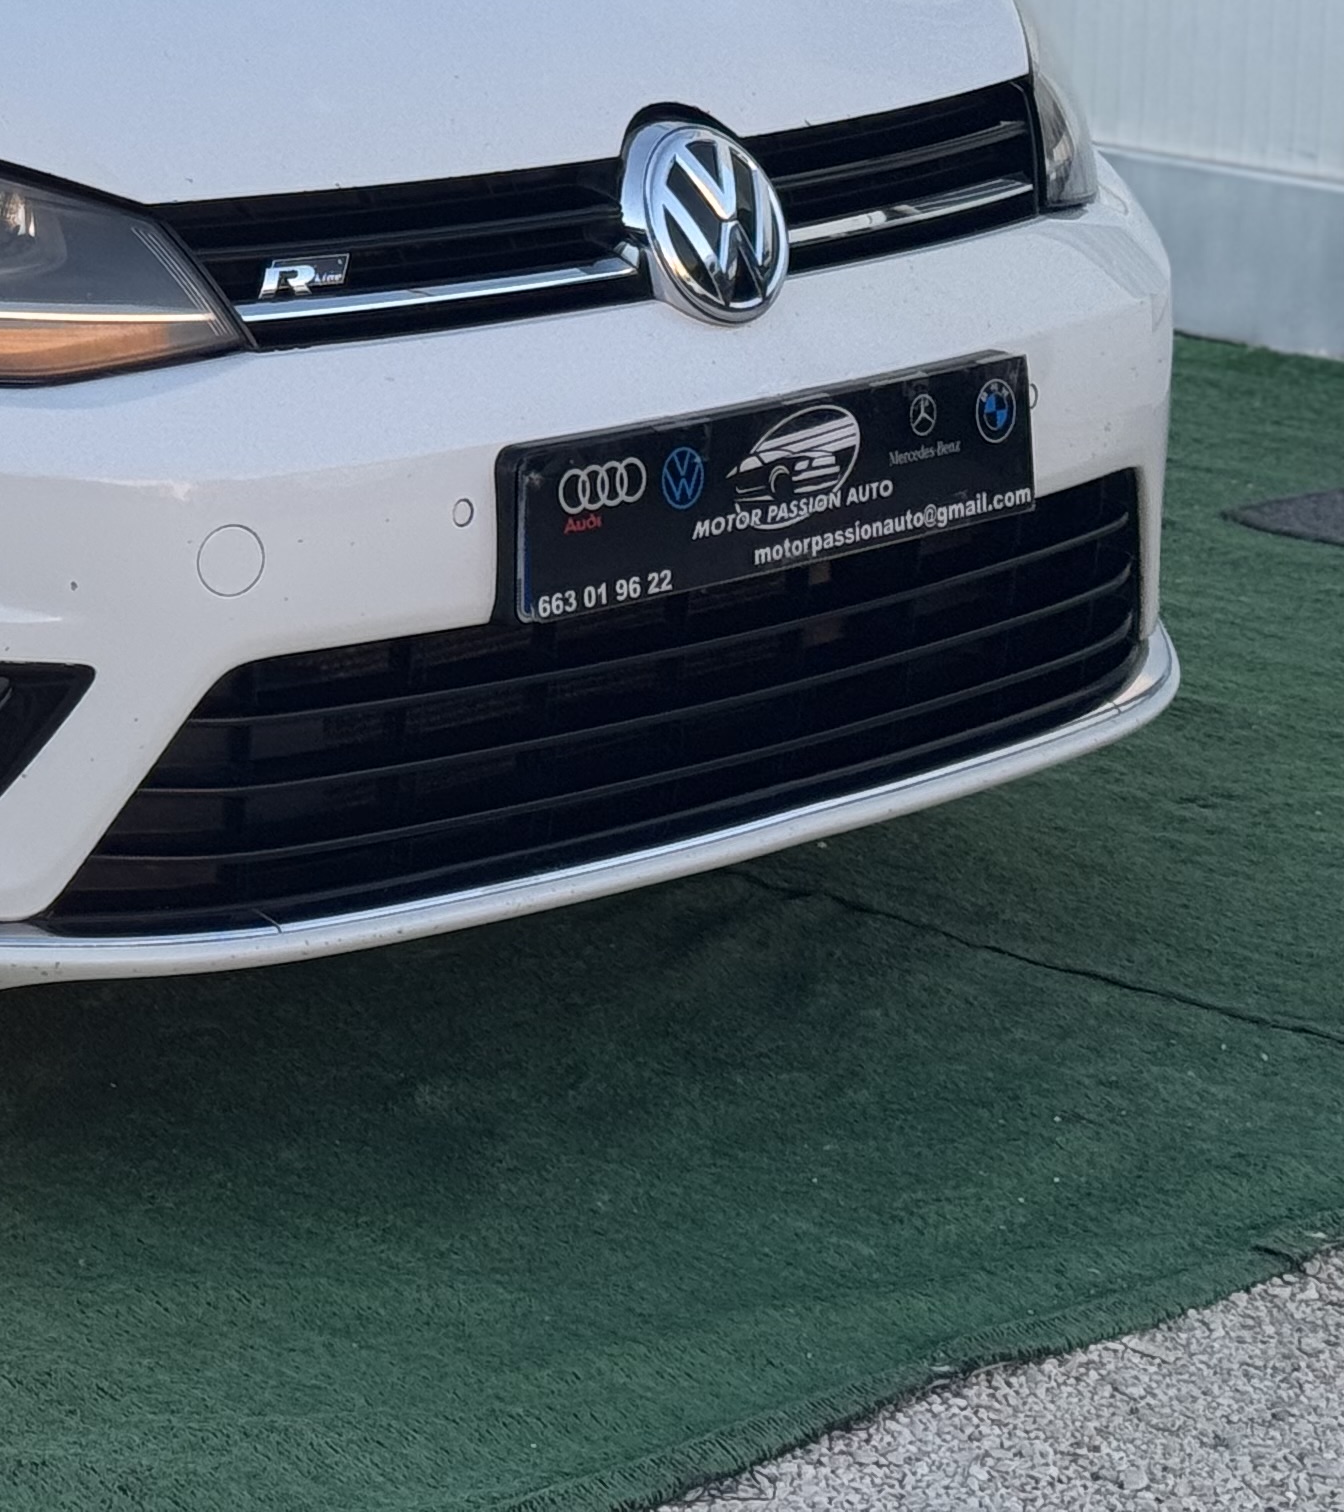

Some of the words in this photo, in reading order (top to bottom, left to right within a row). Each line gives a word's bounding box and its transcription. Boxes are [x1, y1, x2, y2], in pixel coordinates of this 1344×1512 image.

[258, 265, 316, 299] R
[888, 440, 961, 466] Mercedes-Benz
[563, 513, 602, 534] Audi
[692, 508, 762, 540] MOTOR
[767, 490, 842, 523] PASSION
[846, 479, 894, 506] AUTO
[753, 487, 1032, 566] motorpassionauto@gmail.com
[538, 589, 578, 618] 663
[583, 582, 608, 608] 01
[615, 576, 642, 602] 96
[647, 569, 674, 594] 22
